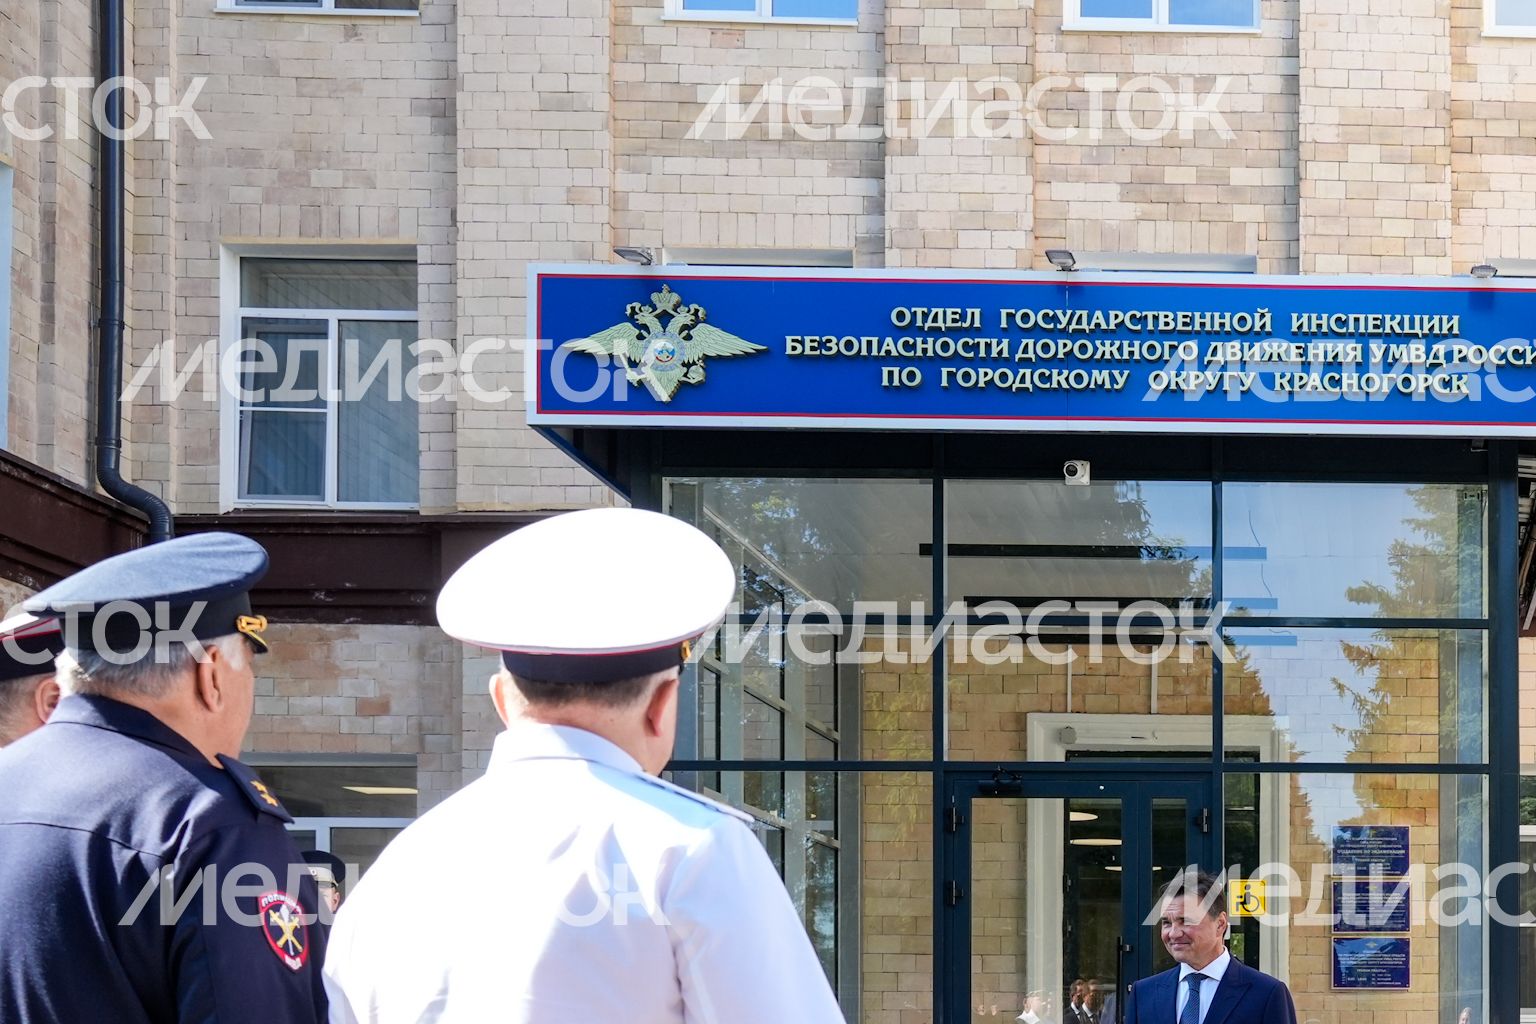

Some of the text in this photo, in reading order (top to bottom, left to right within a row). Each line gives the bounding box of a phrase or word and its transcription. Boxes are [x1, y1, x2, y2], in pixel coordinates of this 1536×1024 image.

[890, 307, 1460, 337] ОТДЕЛ ГОСУДАРСТВЕННОЙ ИНСПЕКЦИИ
[785, 335, 1009, 359] БЕЗОПАСНОСТИ
[1015, 337, 1198, 363] ДОРОЖНОГО
[1204, 341, 1363, 366] ДВИЖЕНИЯ
[1369, 344, 1447, 368] УМВД
[881, 367, 1469, 394] ПО ГОРОДСКОМУ ОКРУГУ КРАСНОГОРСК
